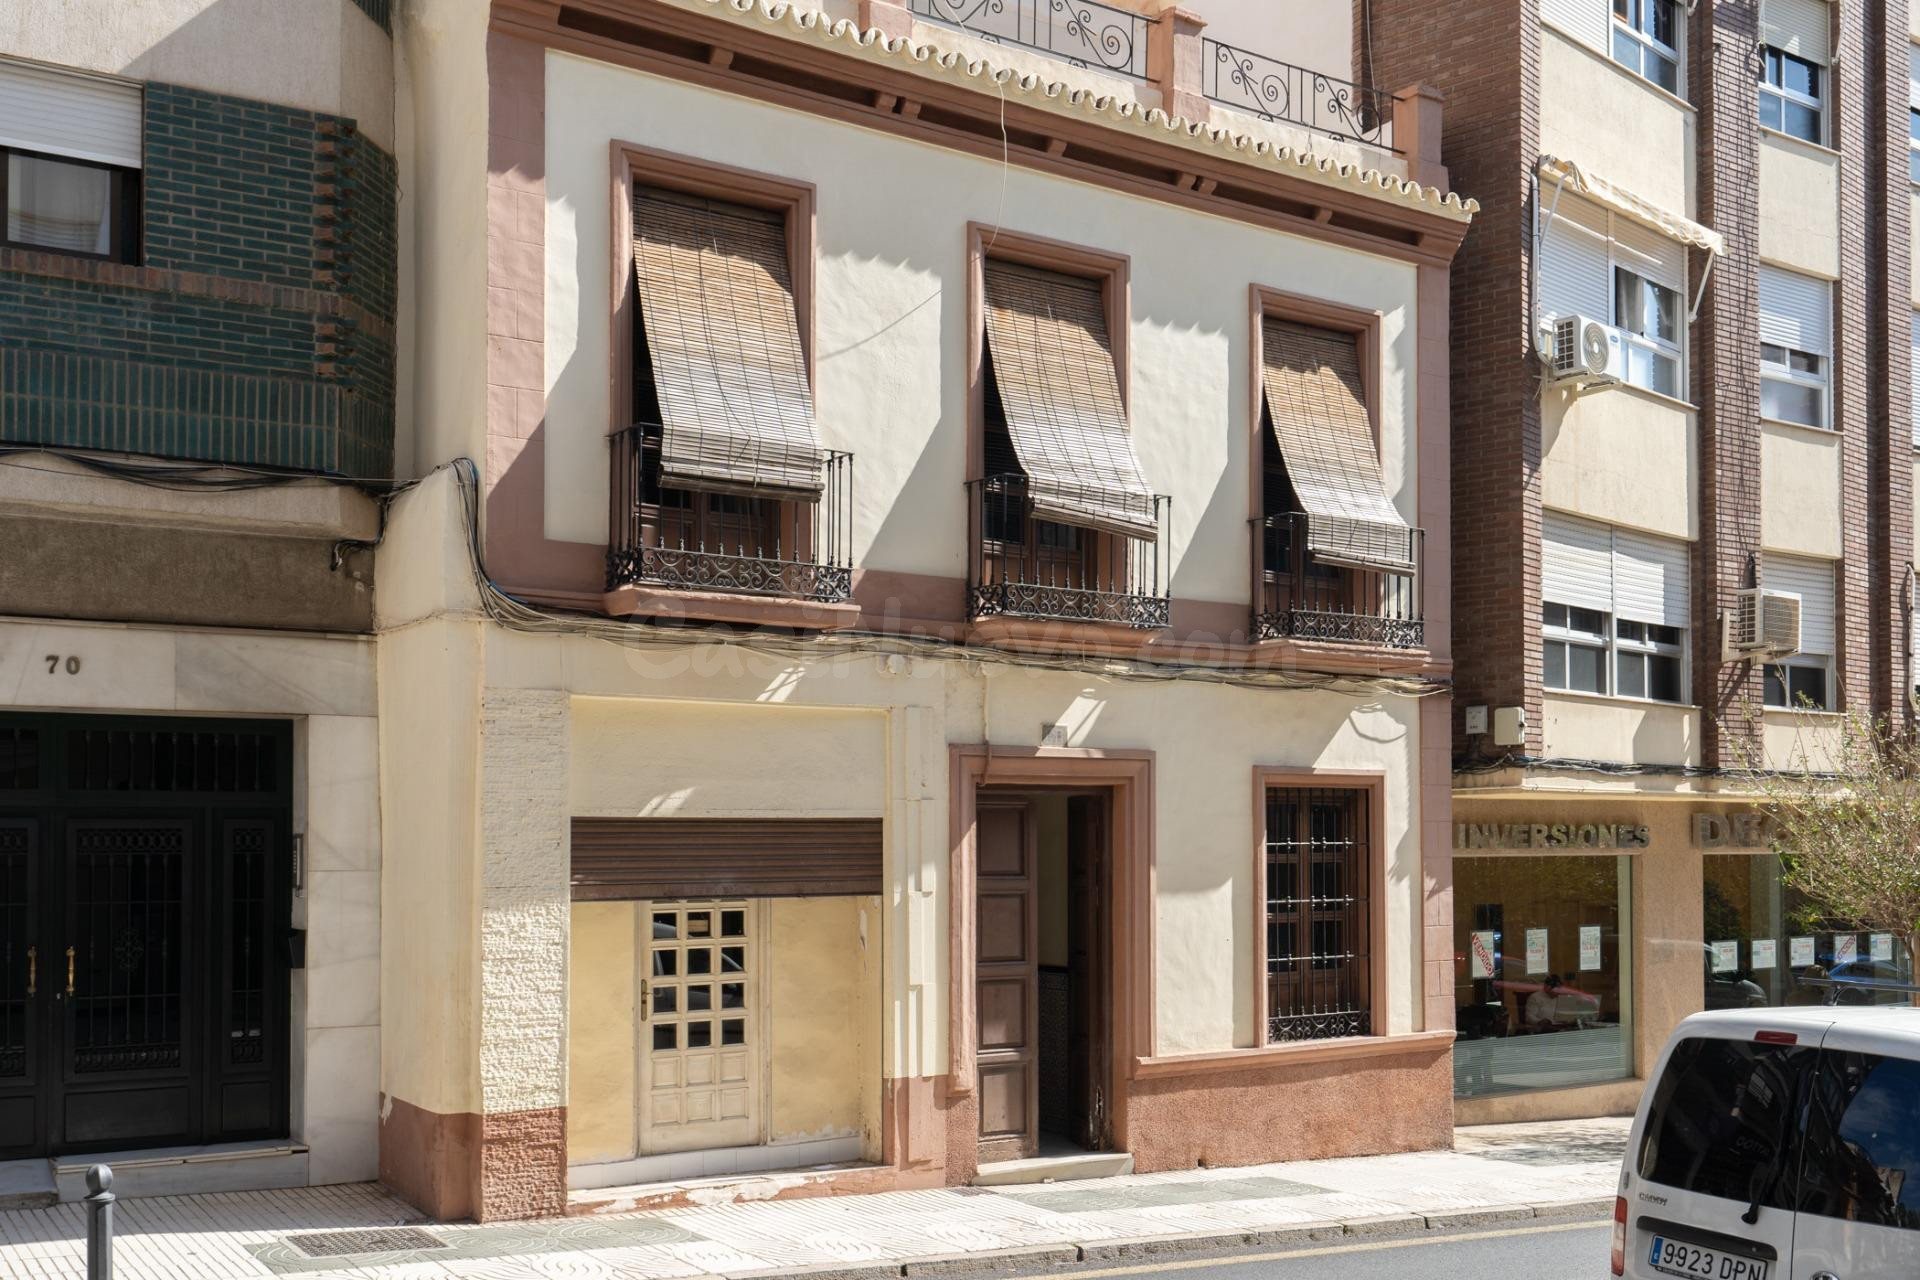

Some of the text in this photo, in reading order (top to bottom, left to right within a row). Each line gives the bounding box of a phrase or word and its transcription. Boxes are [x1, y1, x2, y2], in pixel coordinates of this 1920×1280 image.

[45, 654, 81, 675] 70
[1453, 823, 1650, 849] INVERSIONES
[1663, 1242, 1714, 1275] 9923
[1719, 1256, 1762, 1280] DPN
